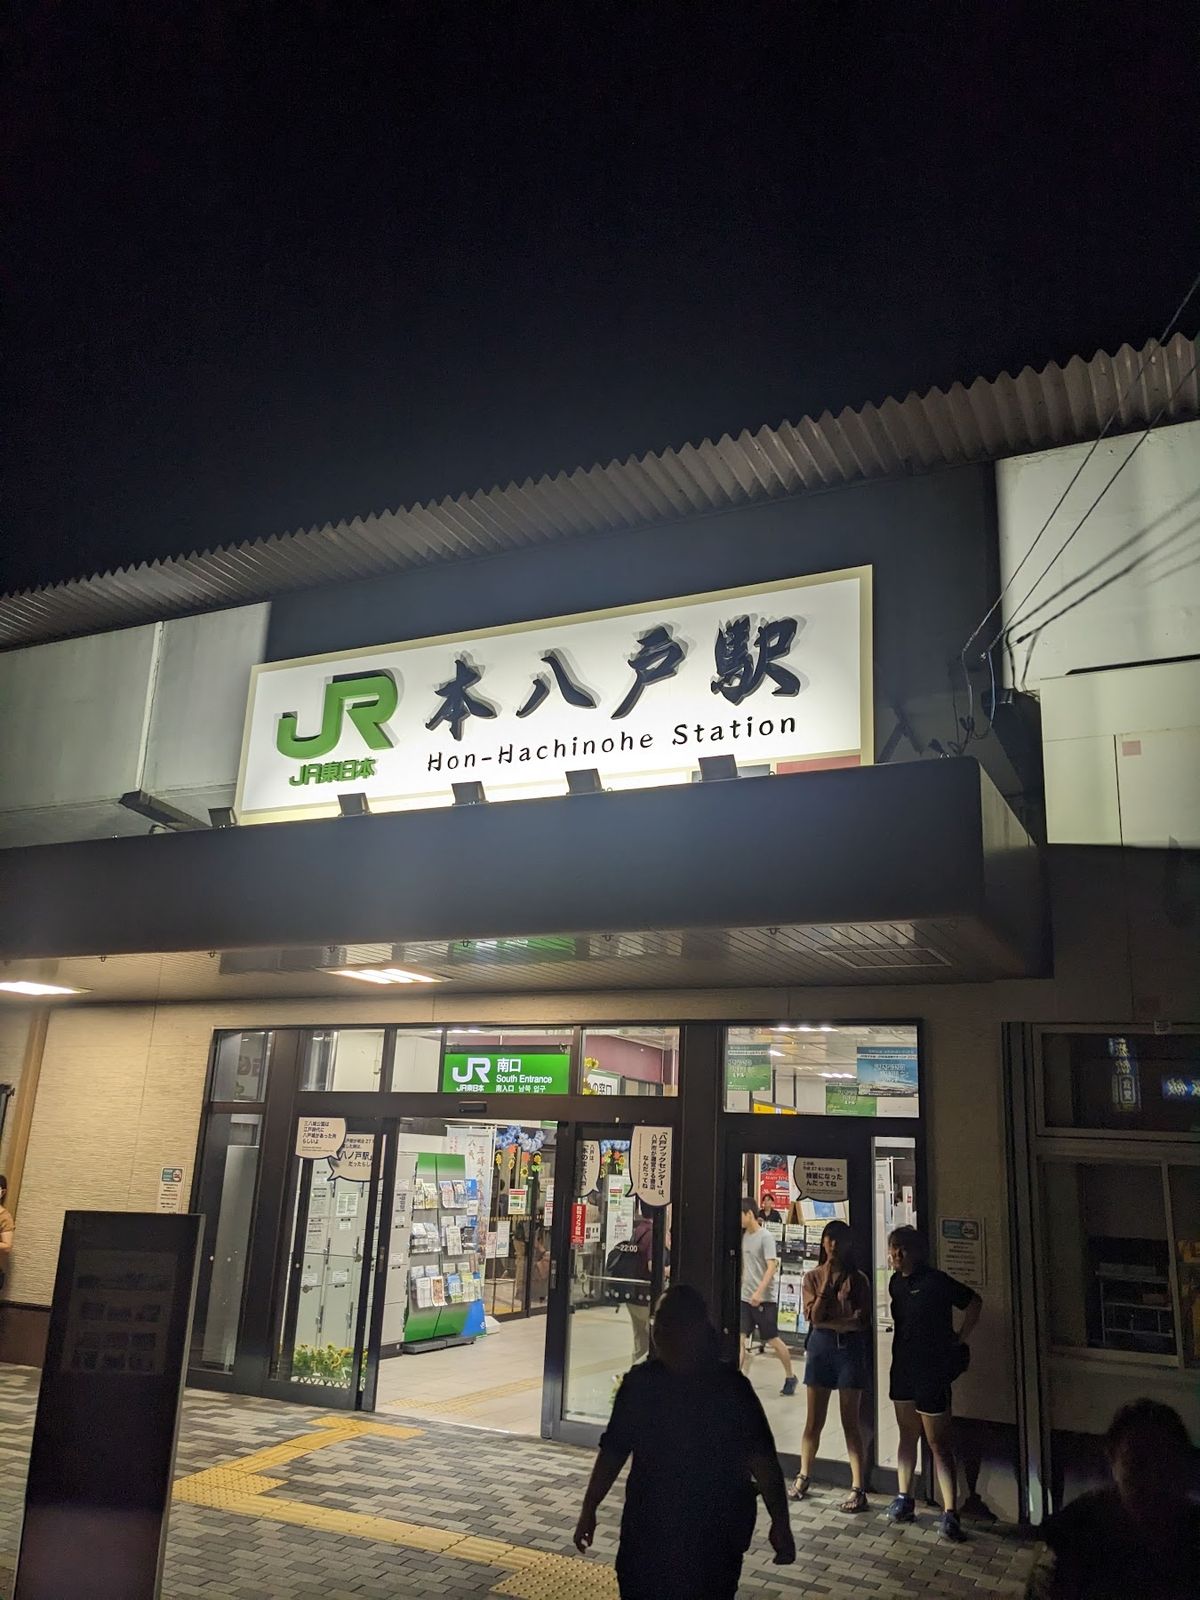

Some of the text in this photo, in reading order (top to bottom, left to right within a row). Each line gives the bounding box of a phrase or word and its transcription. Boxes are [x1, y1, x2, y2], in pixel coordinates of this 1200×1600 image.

[276, 672, 398, 758] JR
[426, 712, 797, 773] Hon-Hachinohe Station
[289, 756, 376, 786] JR東日本
[452, 1057, 491, 1083] JR
[497, 1058, 521, 1073] 南口
[456, 1084, 485, 1092] JR東日本
[496, 1075, 552, 1084] South Entrance
